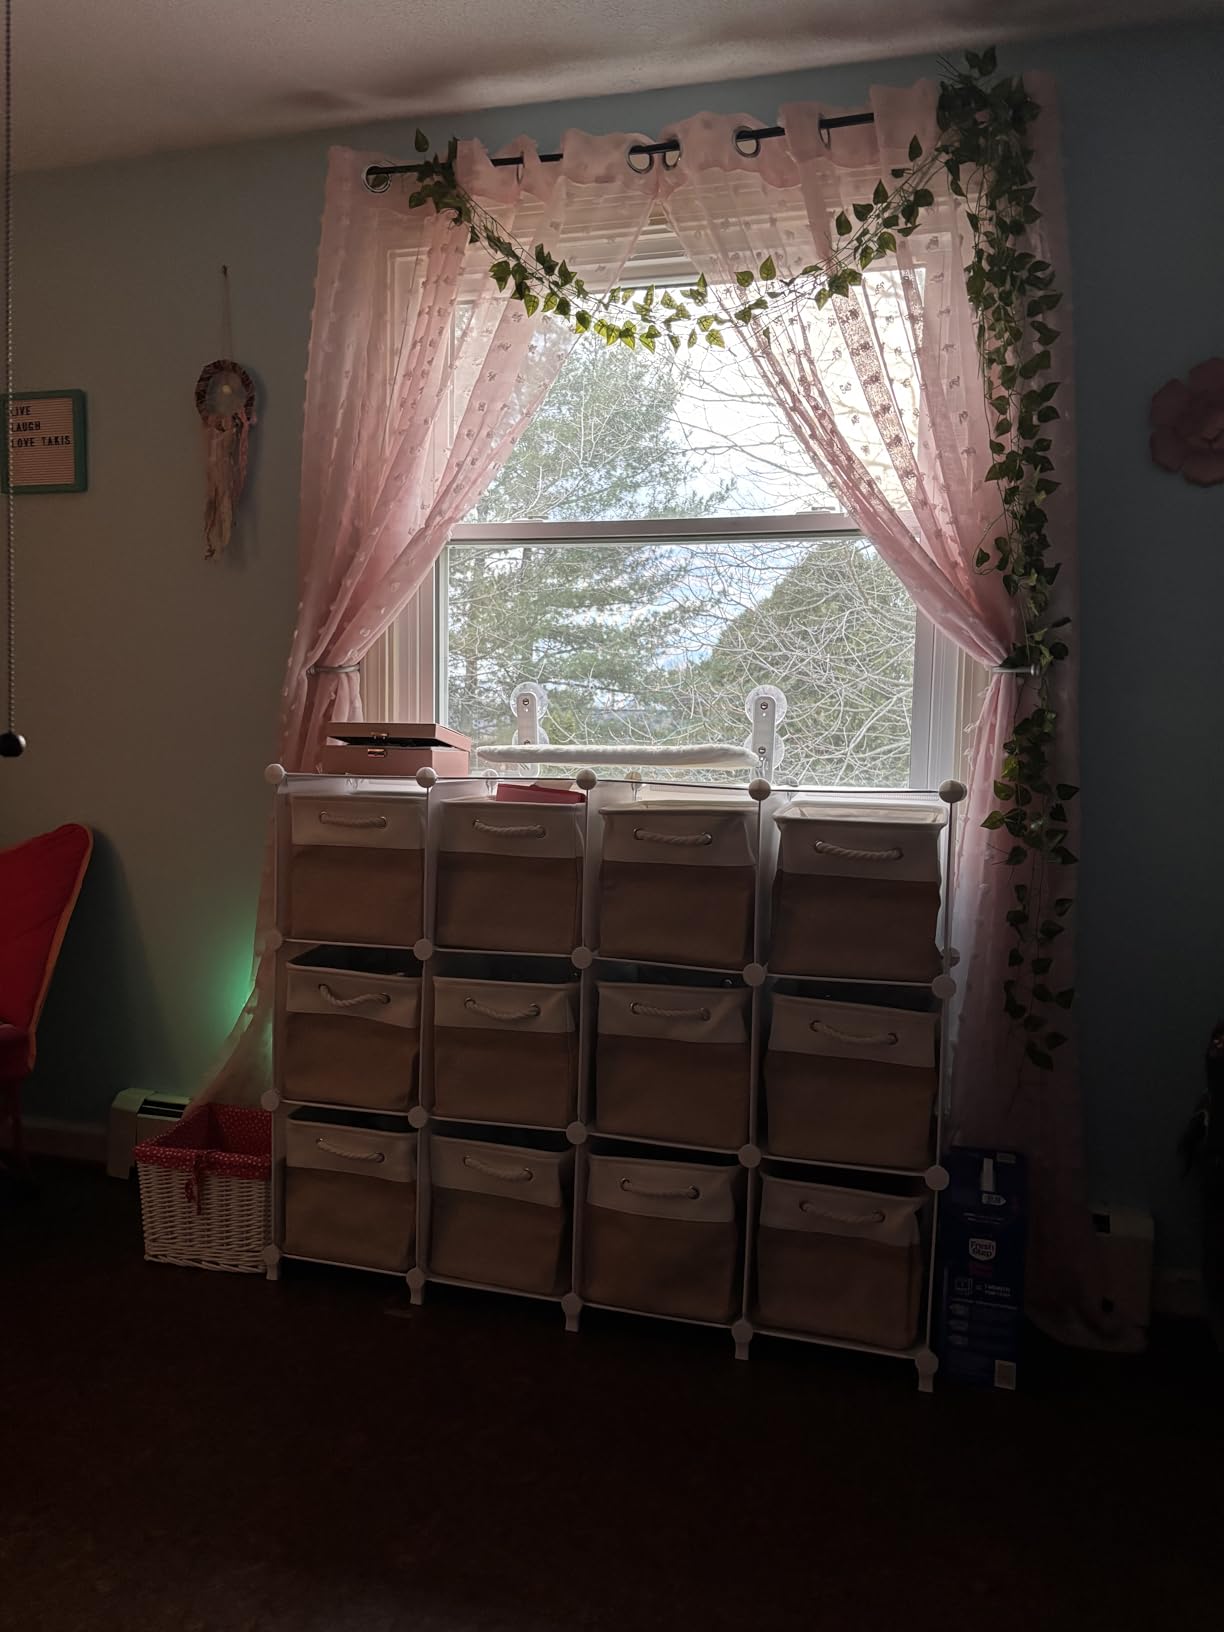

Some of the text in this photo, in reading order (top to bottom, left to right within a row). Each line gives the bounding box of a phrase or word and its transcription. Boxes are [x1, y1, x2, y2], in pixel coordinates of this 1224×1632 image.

[11, 421, 41, 432] LAUGH
[11, 435, 71, 448] LOVE TAKIS
